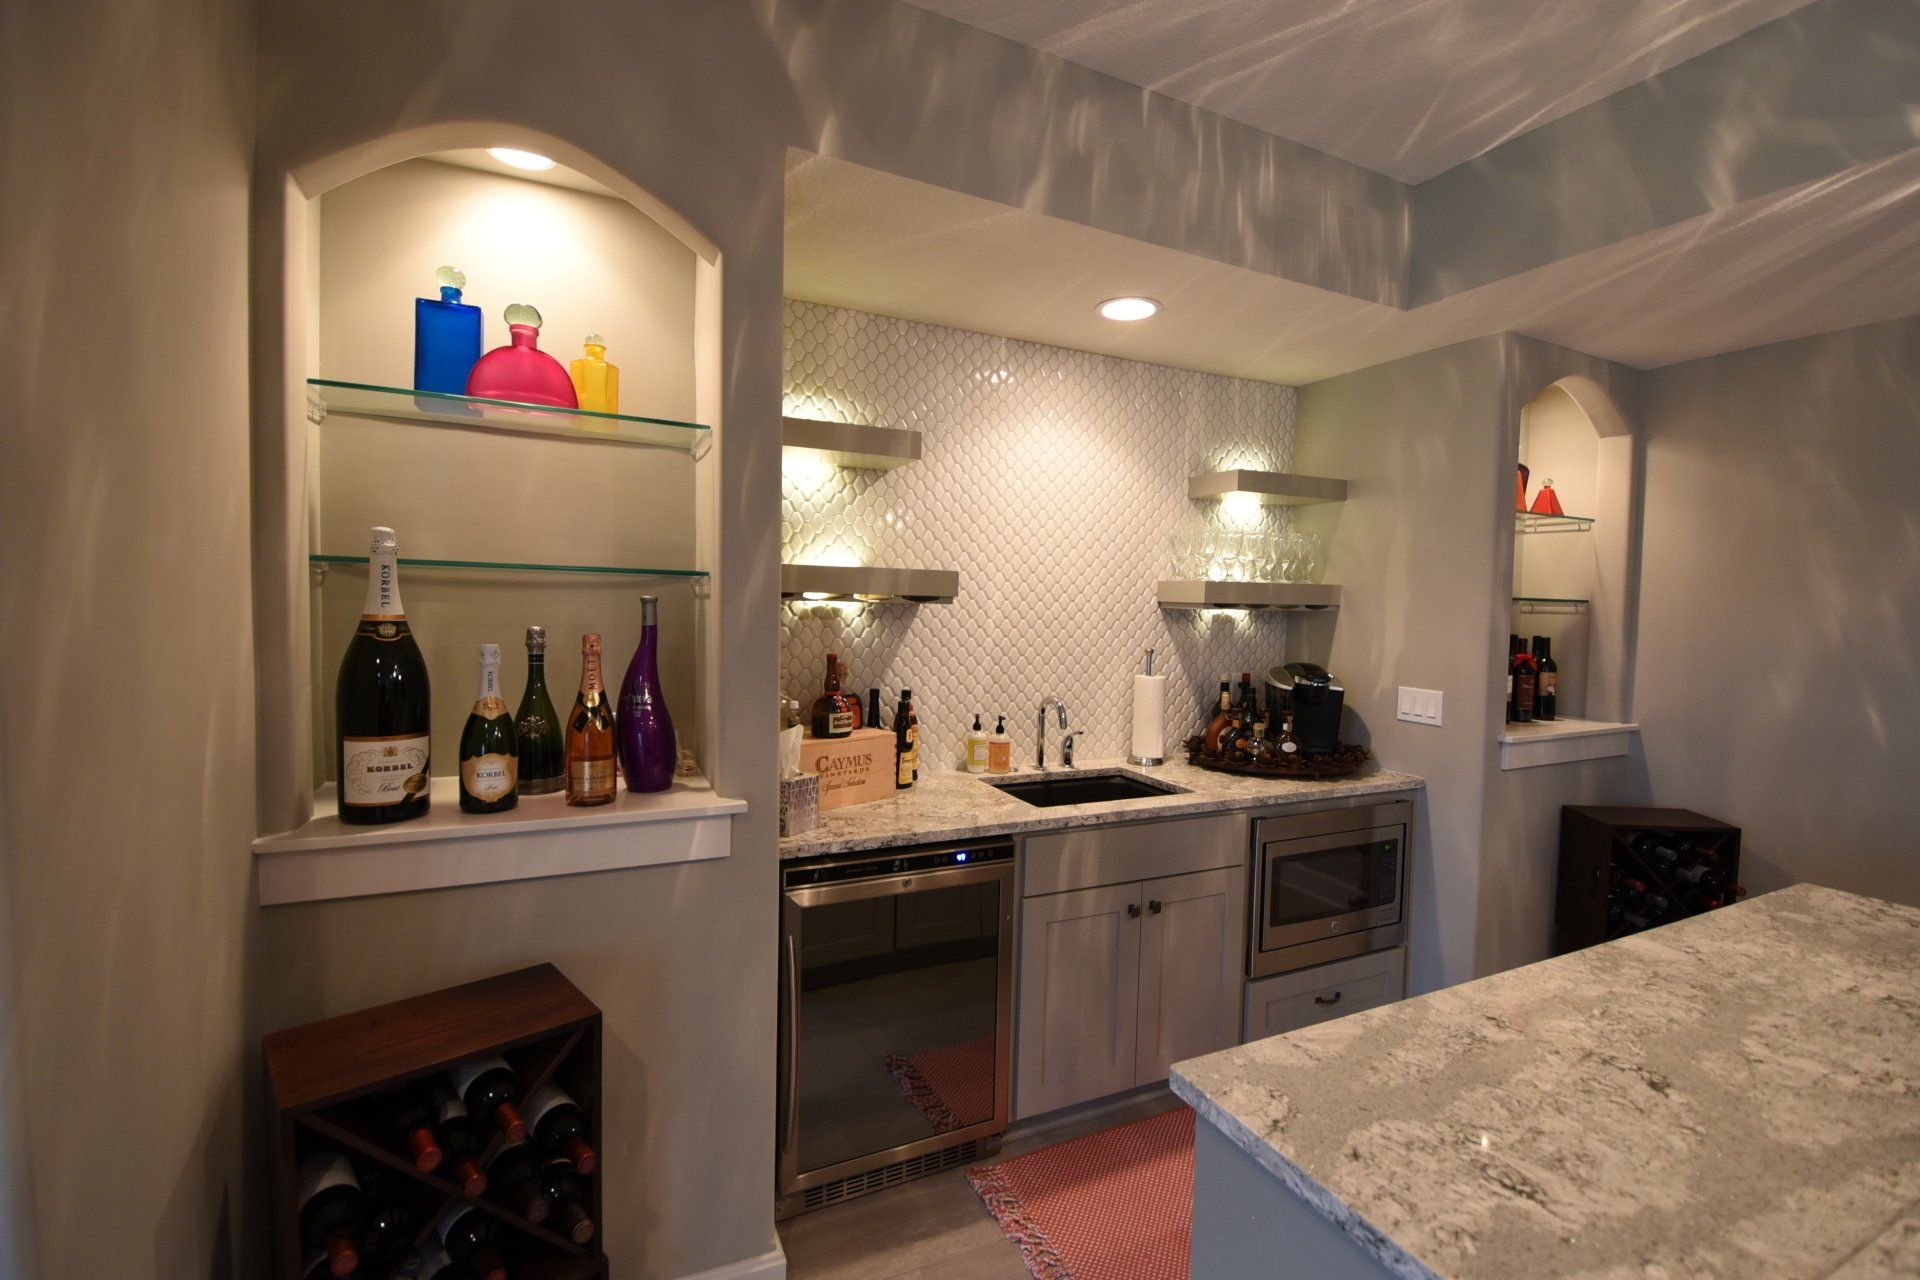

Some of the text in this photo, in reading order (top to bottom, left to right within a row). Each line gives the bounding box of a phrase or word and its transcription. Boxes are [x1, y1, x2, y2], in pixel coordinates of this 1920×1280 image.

[380, 564, 391, 609] KORBEL
[366, 762, 414, 773] KORBEL
[814, 753, 873, 774] CAYMUS
[477, 769, 506, 779] KORBEL
